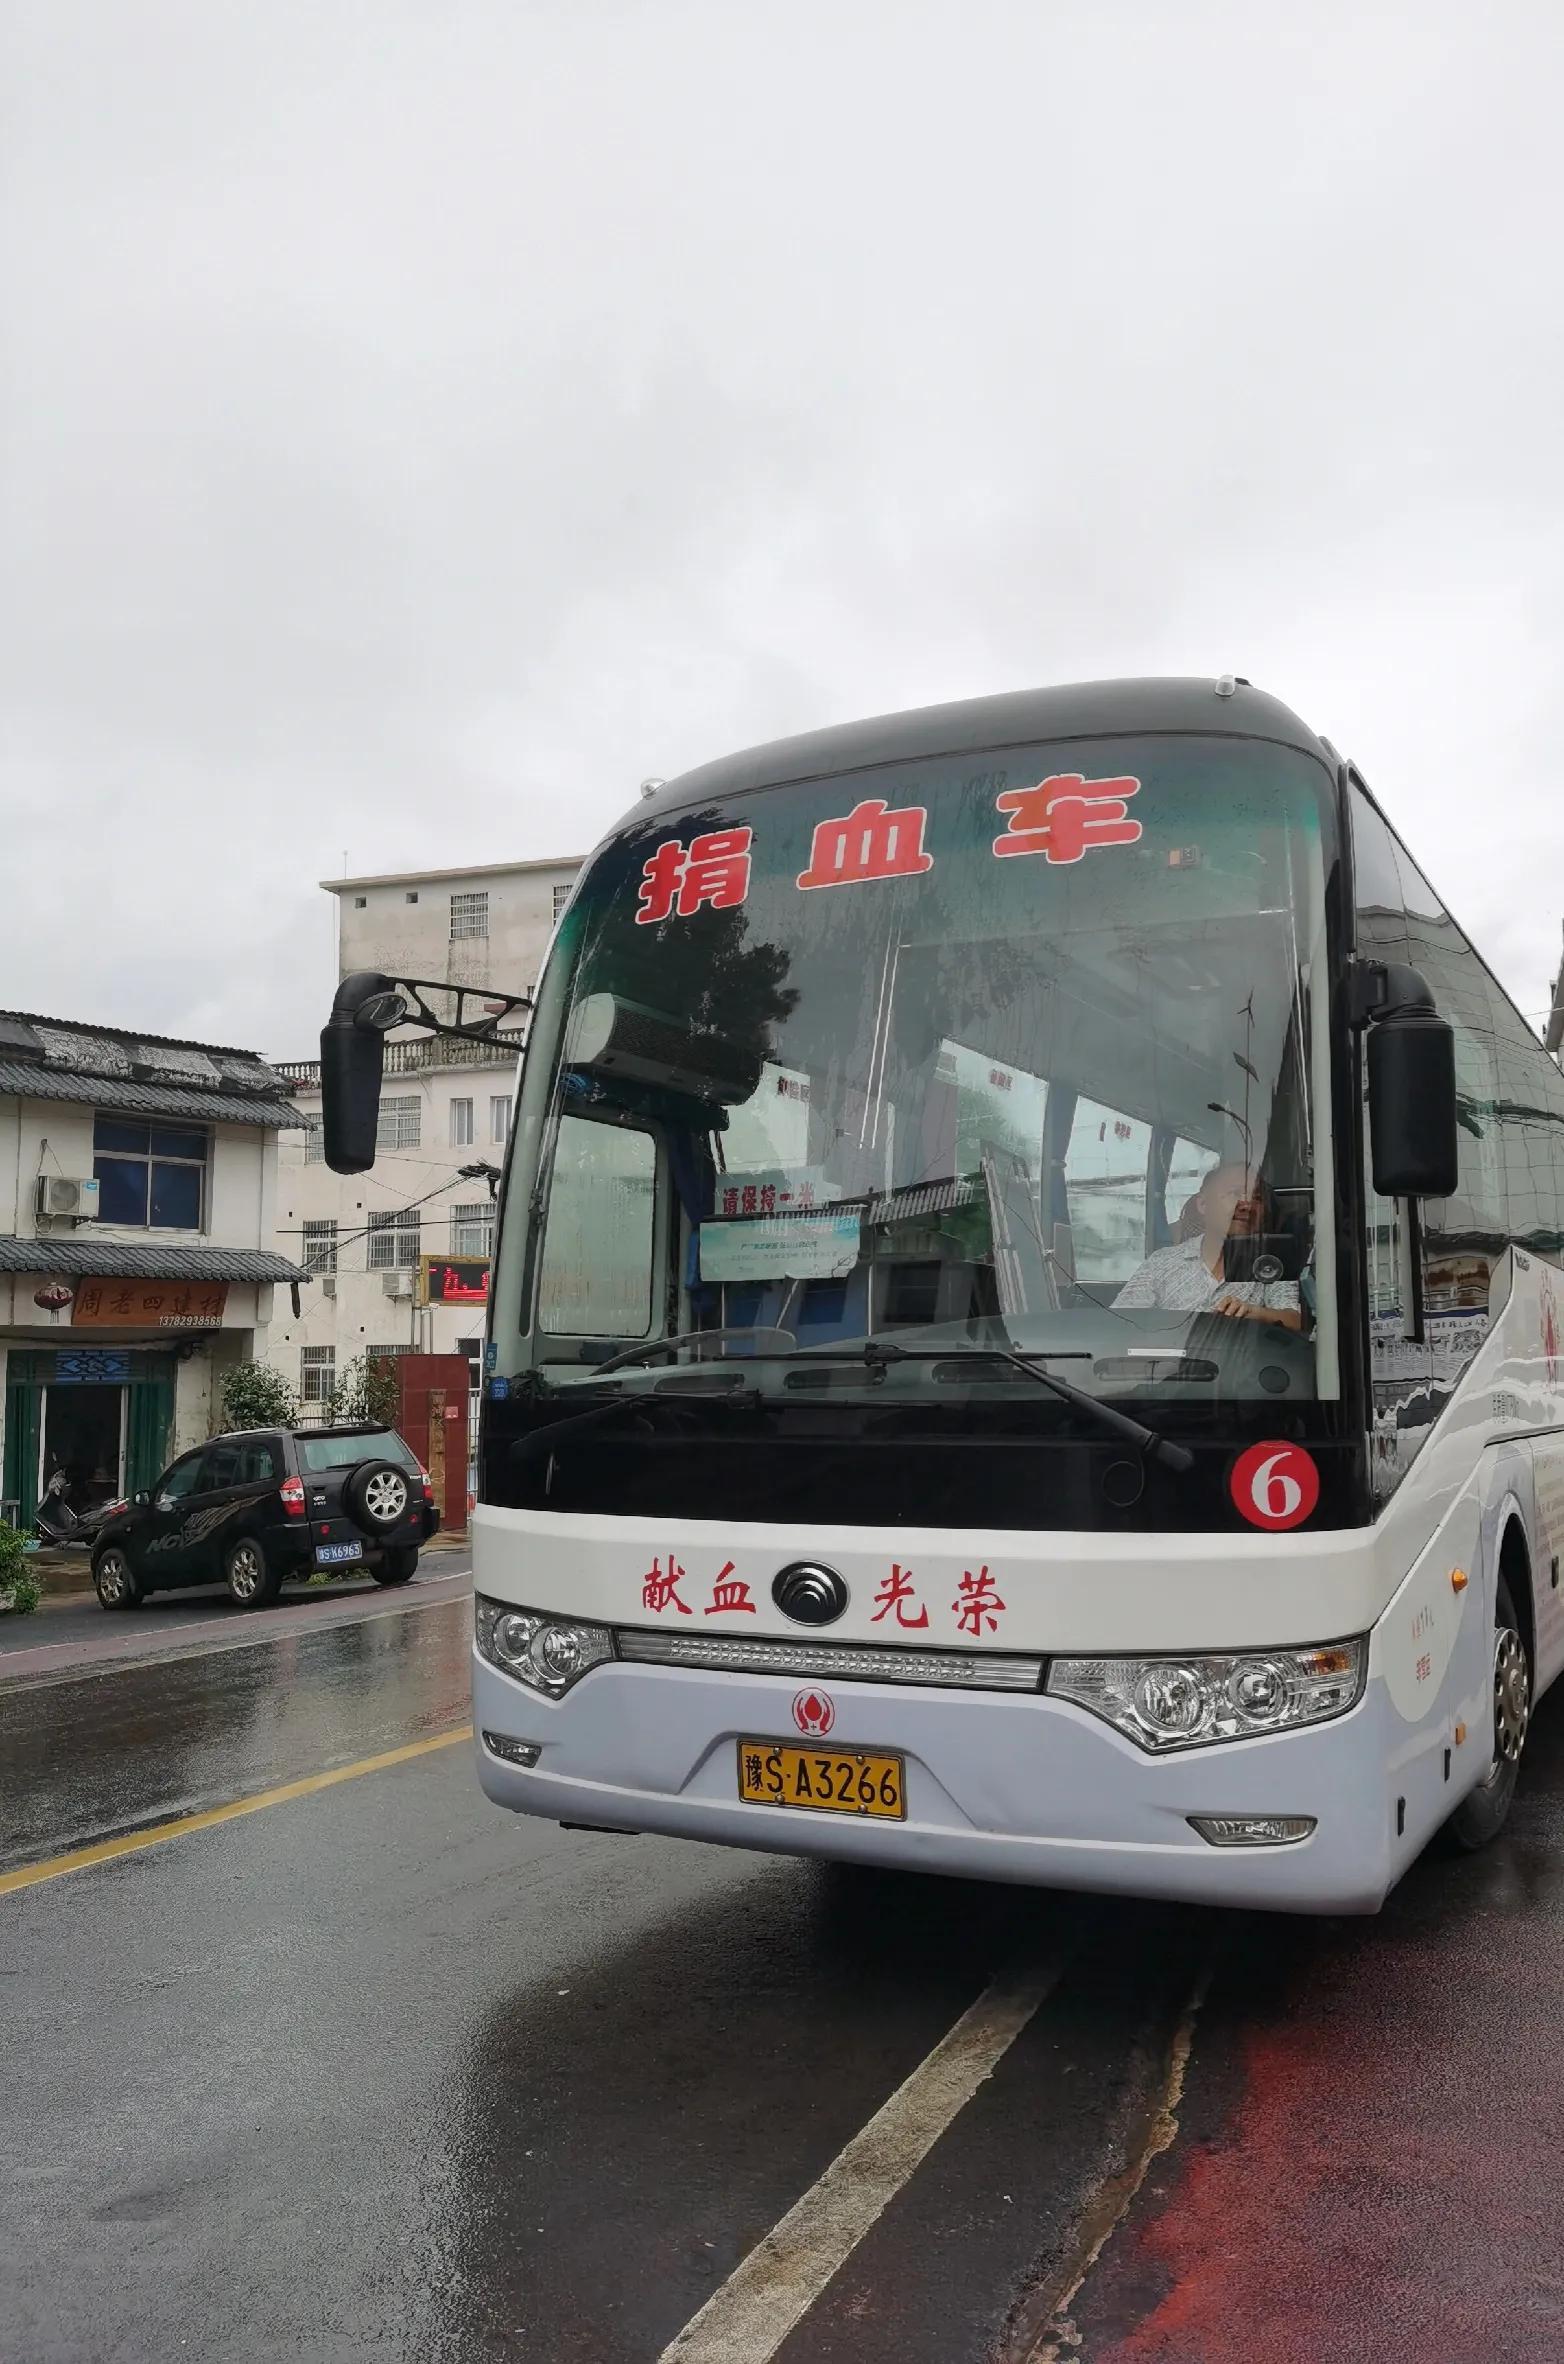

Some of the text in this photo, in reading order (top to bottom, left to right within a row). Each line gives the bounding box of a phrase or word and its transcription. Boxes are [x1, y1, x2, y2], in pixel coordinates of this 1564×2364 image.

[635, 773, 1143, 925] 捐血车
[77, 1287, 222, 1317] 周老四建材
[1251, 1451, 1302, 1518] 6
[642, 1554, 1006, 1637] 献血 光荣
[745, 1753, 898, 1807] 豫S·A3266
